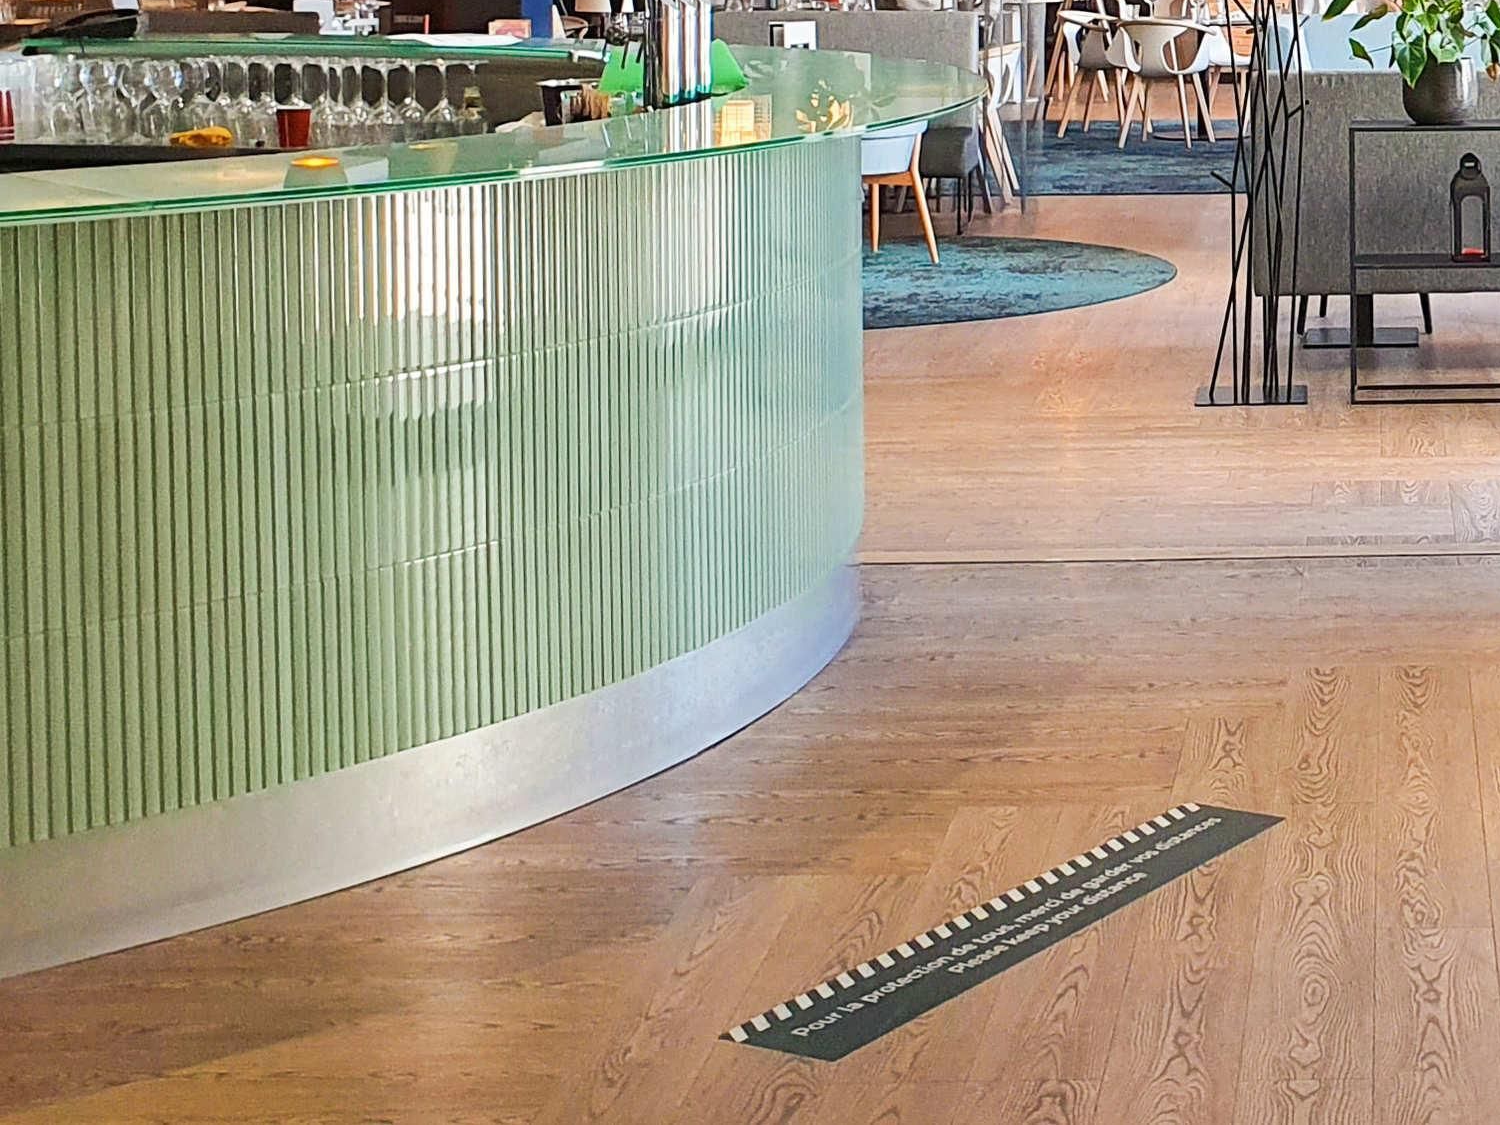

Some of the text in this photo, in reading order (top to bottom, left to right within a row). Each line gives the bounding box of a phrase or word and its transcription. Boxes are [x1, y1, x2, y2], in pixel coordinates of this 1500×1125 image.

[836, 1002, 865, 1013] la
[861, 956, 955, 1004] protection
[951, 943, 978, 956] de
[1014, 898, 1064, 923] merci
[1060, 888, 1085, 900] de
[1081, 862, 1133, 889] garder
[1128, 850, 1160, 863] vos
[1155, 817, 1222, 851] distances
[948, 872, 1148, 974] Please keep your distance
